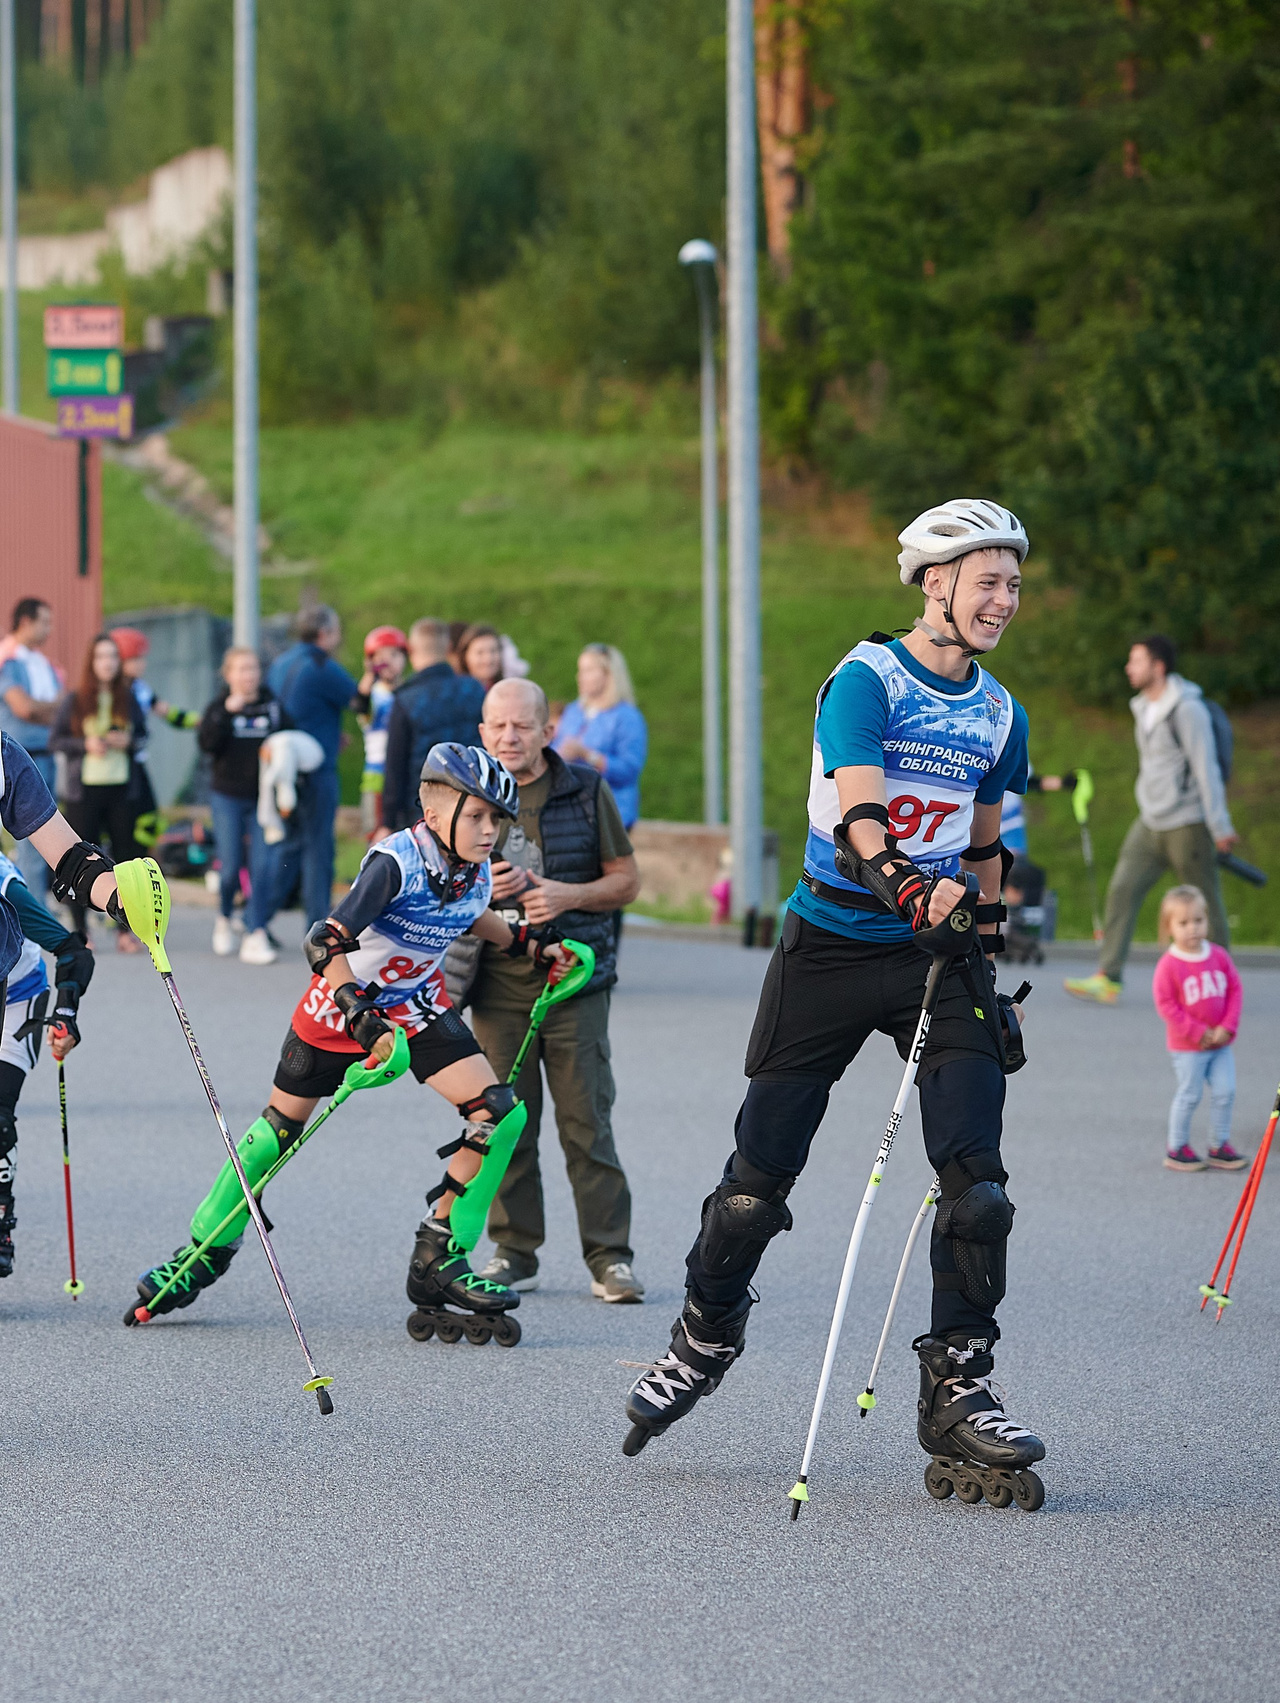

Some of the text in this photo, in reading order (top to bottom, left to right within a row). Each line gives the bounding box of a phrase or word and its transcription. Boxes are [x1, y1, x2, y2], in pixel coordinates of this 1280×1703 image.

[899, 757, 968, 781] ОБЛАСТЬ
[888, 794, 960, 843] 97
[1183, 969, 1228, 1006] GAP
